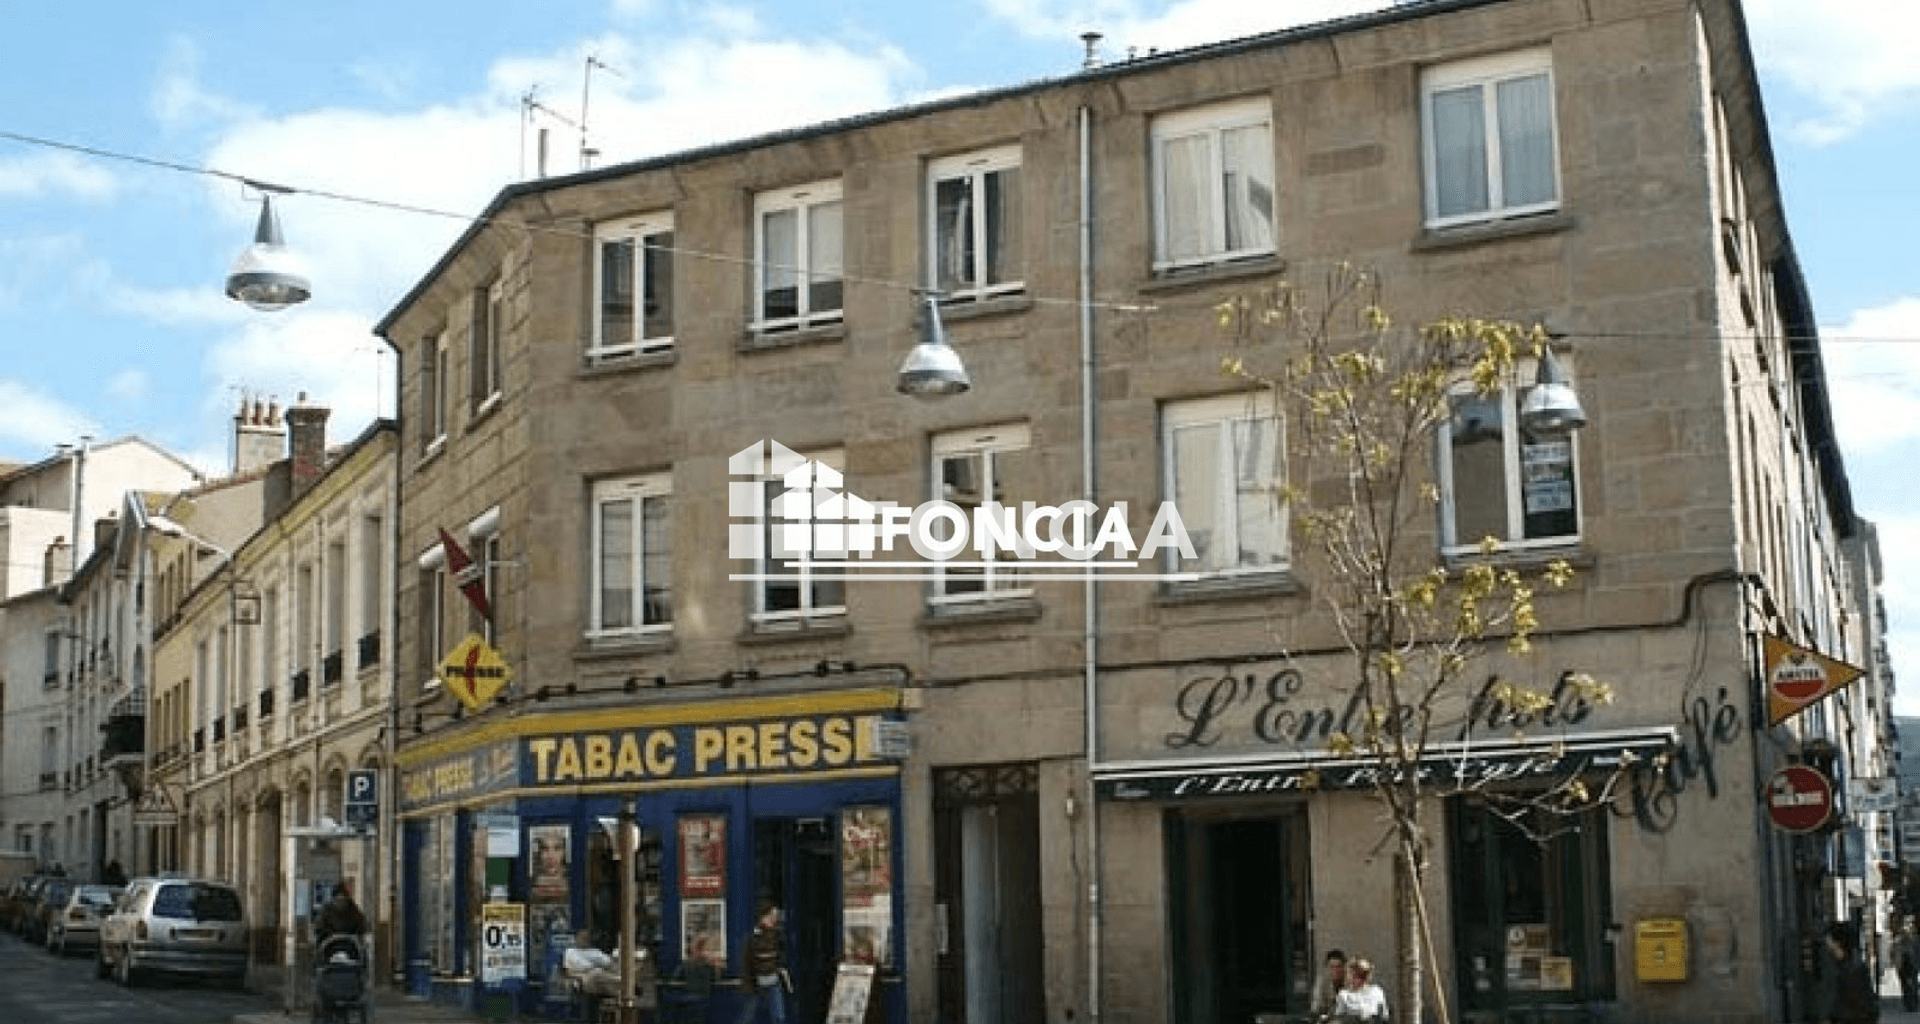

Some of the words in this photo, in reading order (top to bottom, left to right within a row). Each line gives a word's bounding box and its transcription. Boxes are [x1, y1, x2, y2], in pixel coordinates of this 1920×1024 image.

[1164, 668, 1414, 749] L'Ente
[528, 730, 678, 783] TABAC
[354, 776, 370, 797] P
[1174, 764, 1320, 796] l'Entr
